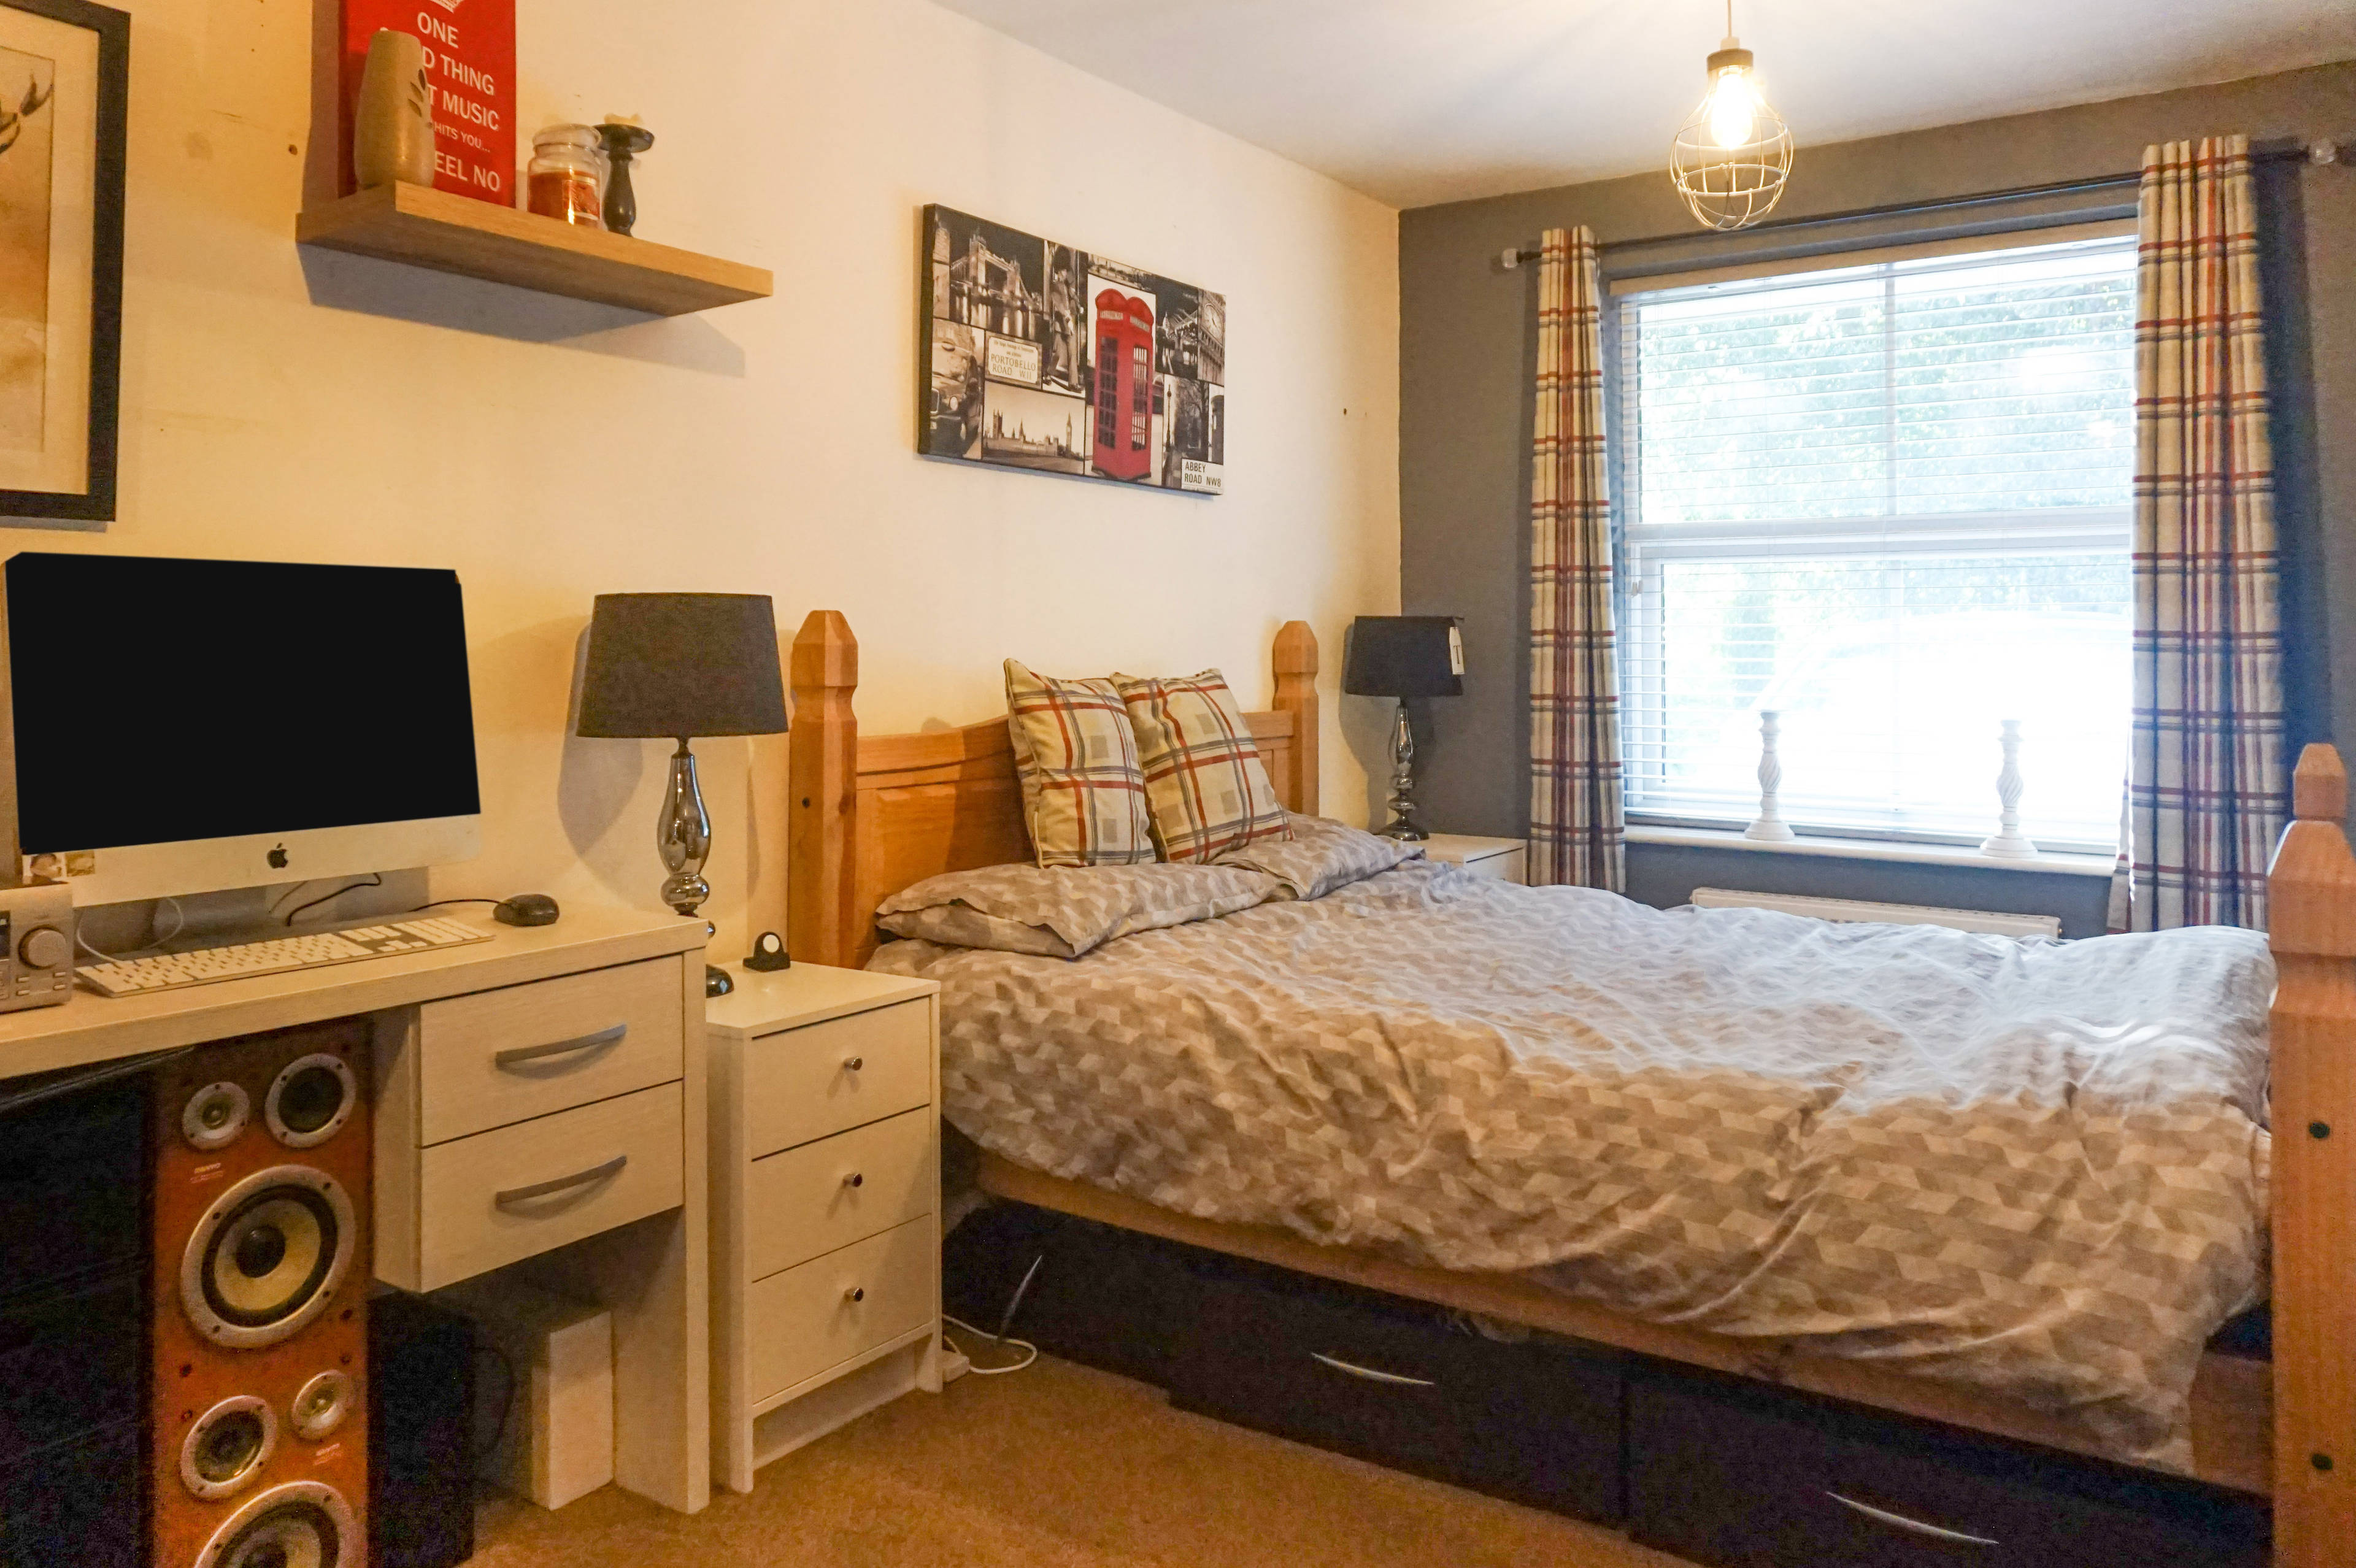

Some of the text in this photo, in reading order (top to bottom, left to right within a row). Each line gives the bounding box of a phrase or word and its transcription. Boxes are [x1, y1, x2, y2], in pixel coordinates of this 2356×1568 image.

[417, 12, 459, 48] ONE
[440, 53, 495, 96] THING
[443, 90, 499, 131] MUSIC
[434, 121, 458, 140] HITS
[434, 150, 500, 192] EEL NO
[991, 353, 1036, 371] PORTOBELLO
[993, 363, 1012, 375] ROAD
[1185, 461, 1206, 472] ABBEY
[1185, 474, 1221, 487] ROAD NW8
